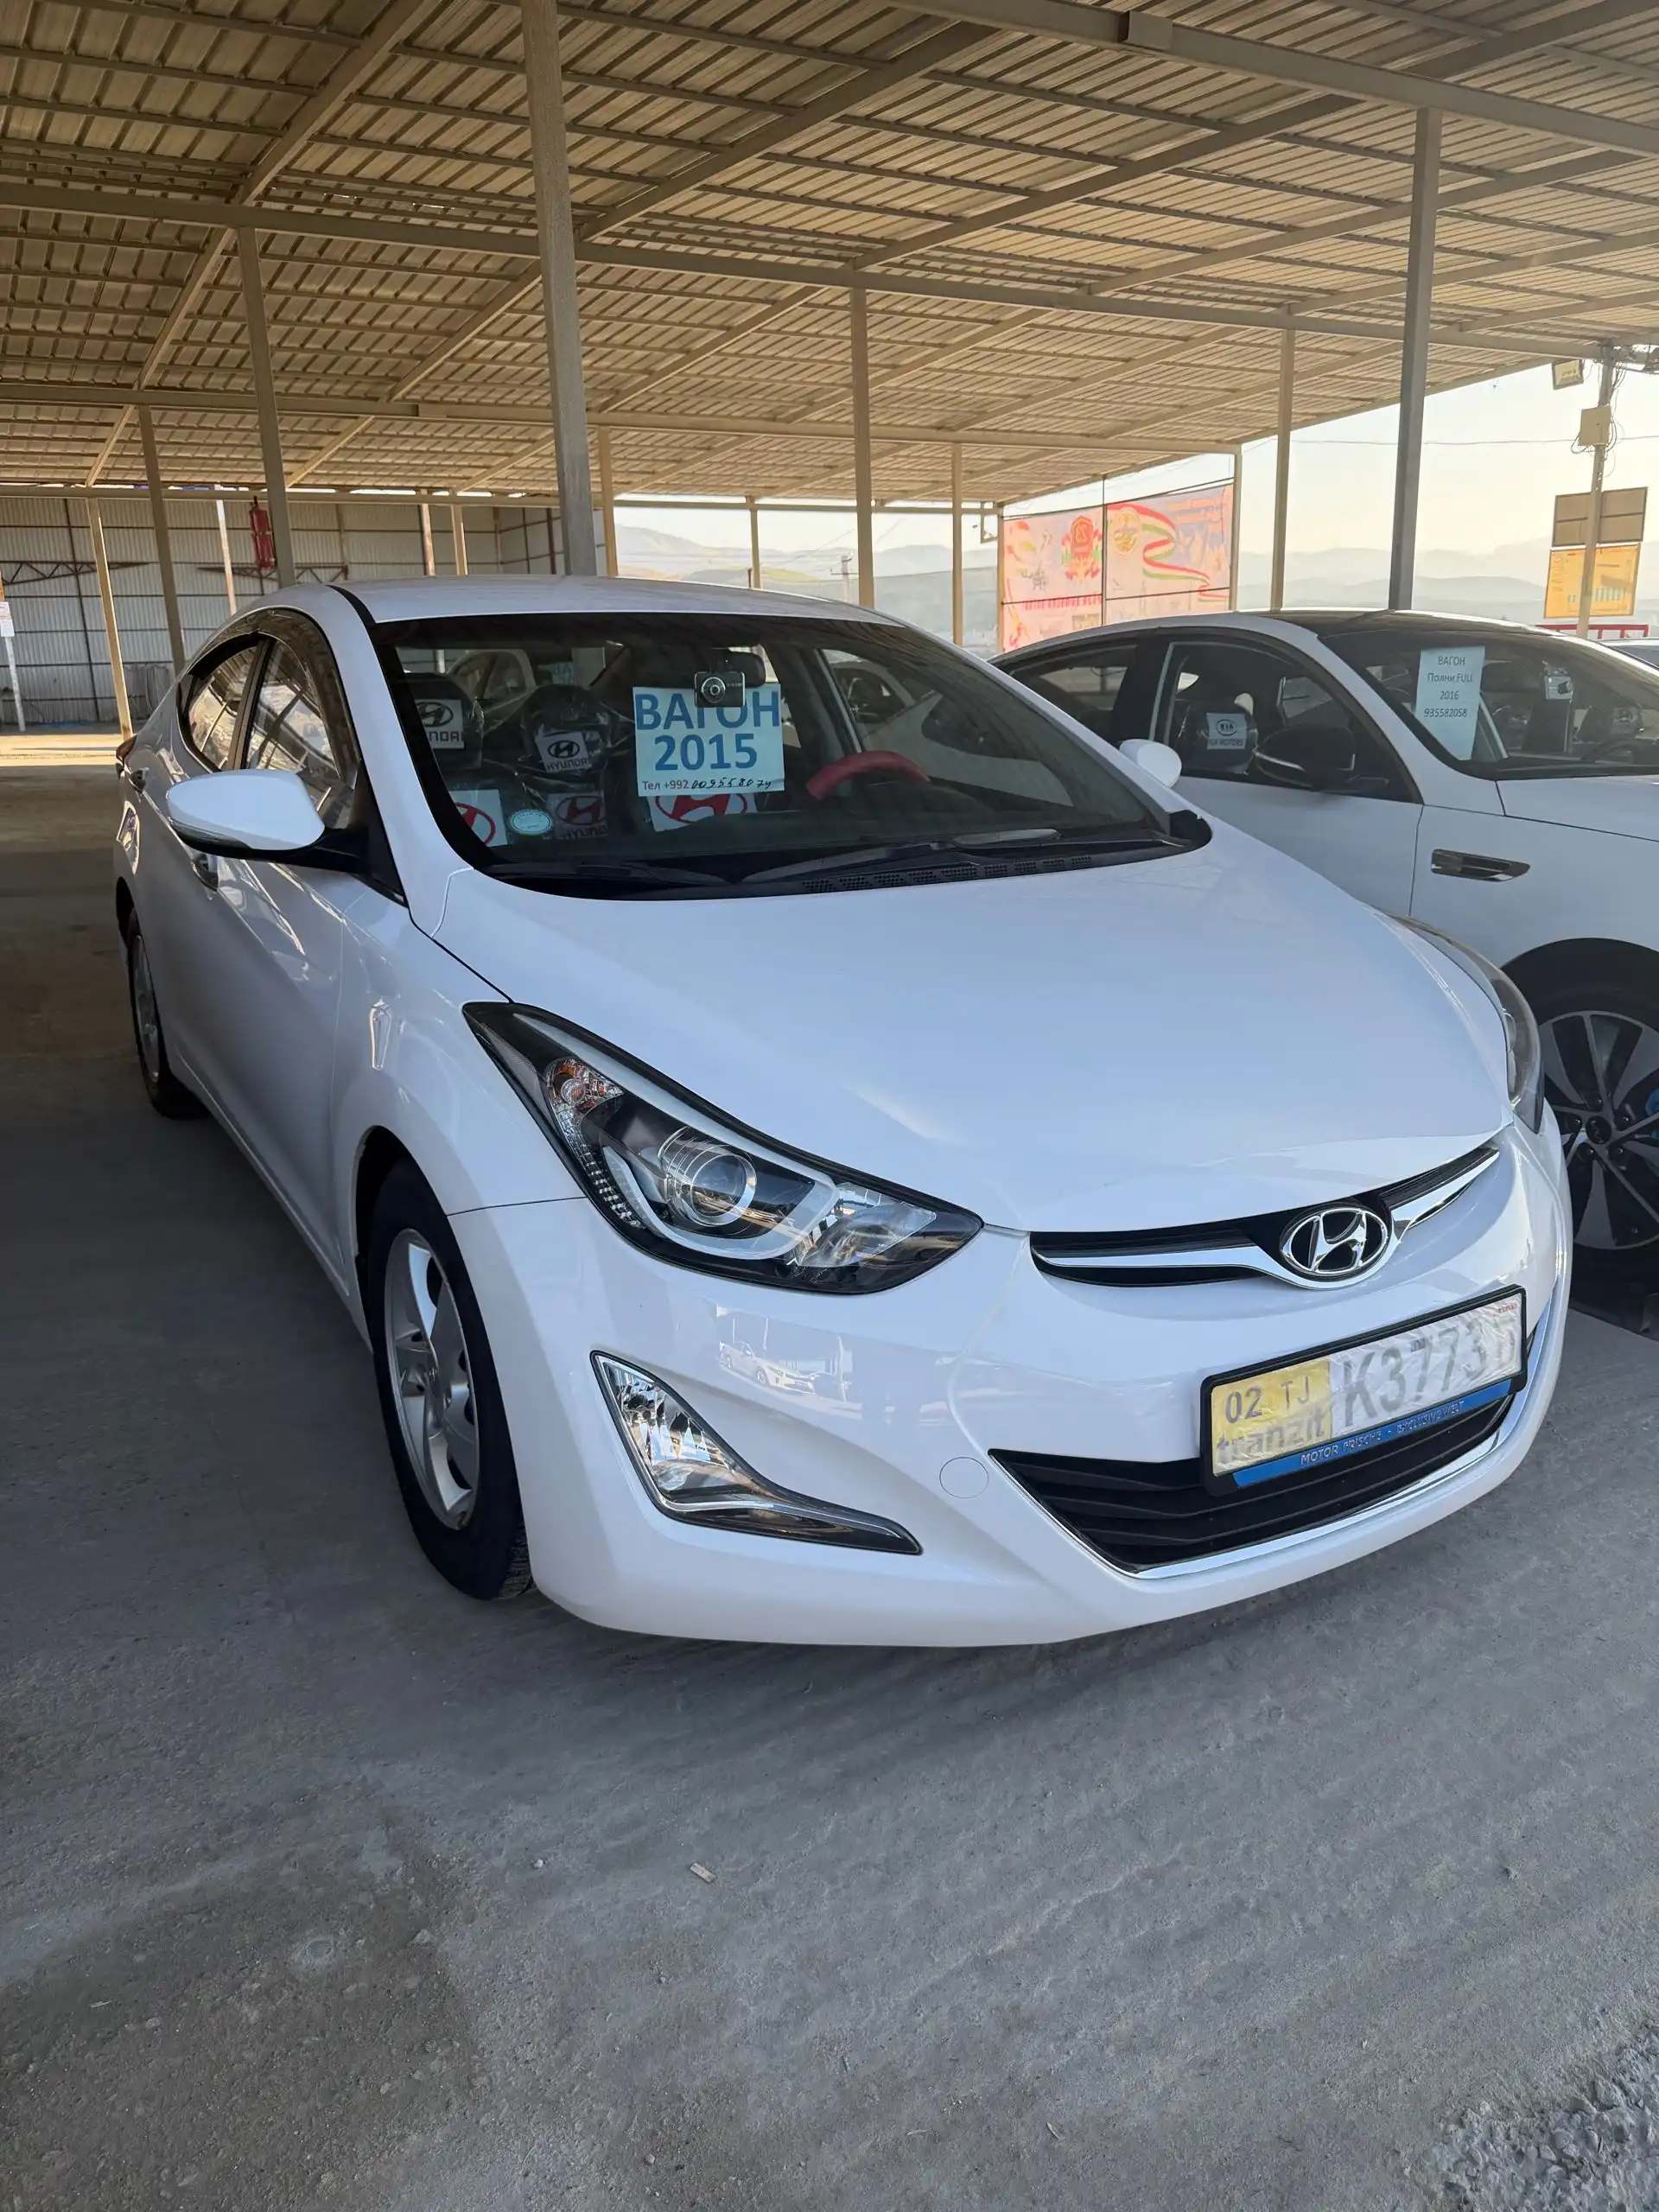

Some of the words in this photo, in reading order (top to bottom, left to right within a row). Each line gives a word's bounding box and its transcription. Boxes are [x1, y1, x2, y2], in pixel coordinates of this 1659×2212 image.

[1438, 656, 1465, 665] ВАГОН
[1457, 673, 1473, 683] FULL
[1440, 690, 1459, 700] 2016
[654, 733, 758, 771] 2015
[642, 780, 660, 791] Тел
[1225, 1386, 1262, 1424] 02
[1281, 1376, 1310, 1409] TJ
[1300, 1445, 1338, 1466] MOTOR
